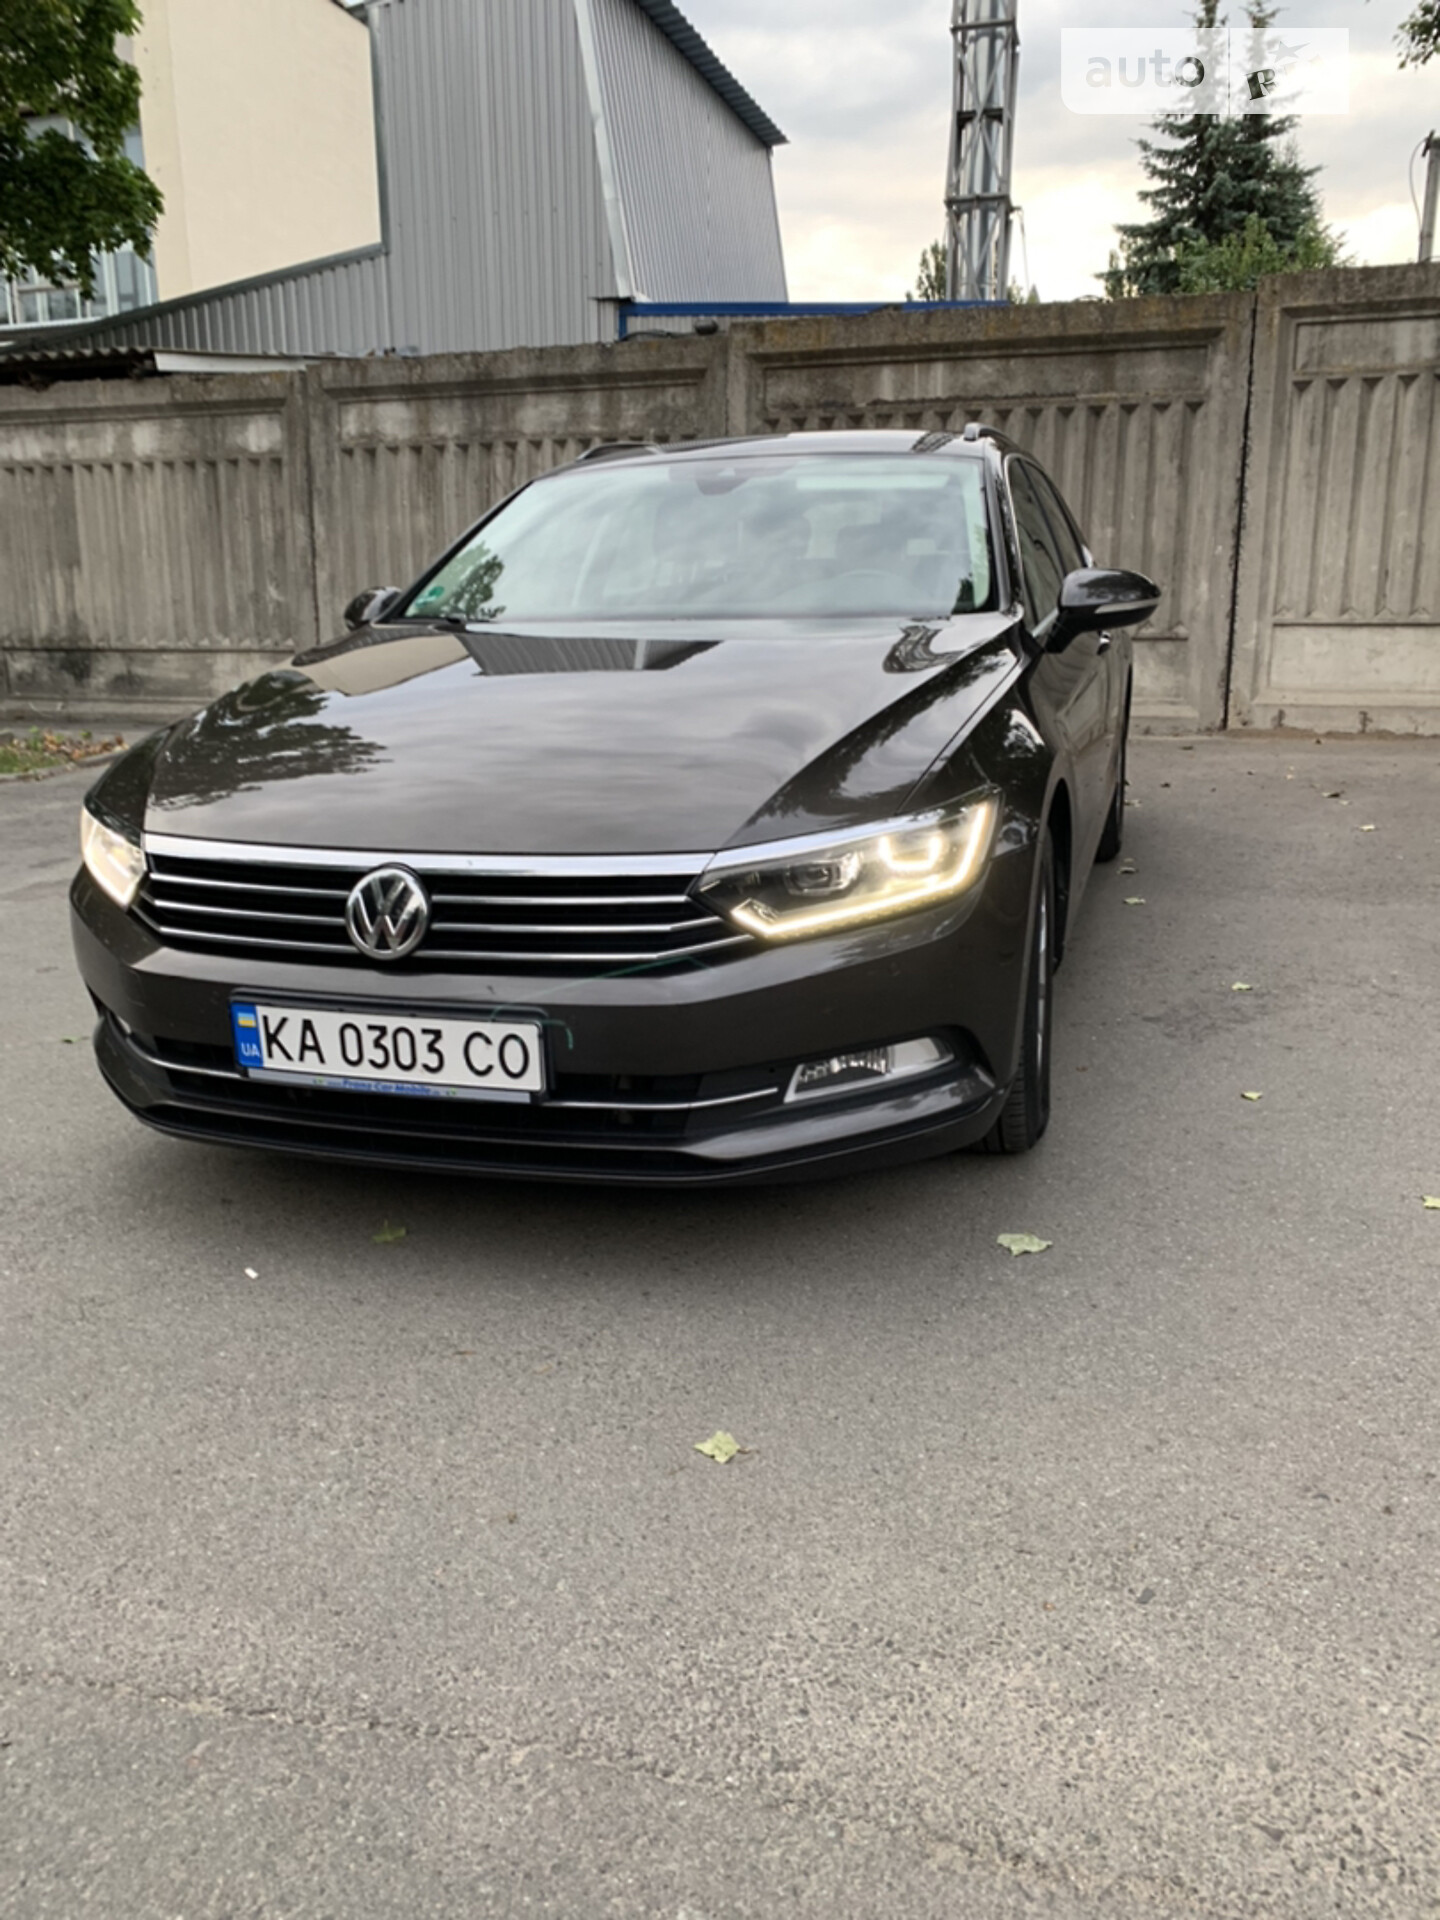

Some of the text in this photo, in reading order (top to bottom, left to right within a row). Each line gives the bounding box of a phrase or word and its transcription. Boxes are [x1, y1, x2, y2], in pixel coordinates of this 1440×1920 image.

[241, 1042, 260, 1057] UA
[262, 1015, 530, 1080] KA 0303 CO
